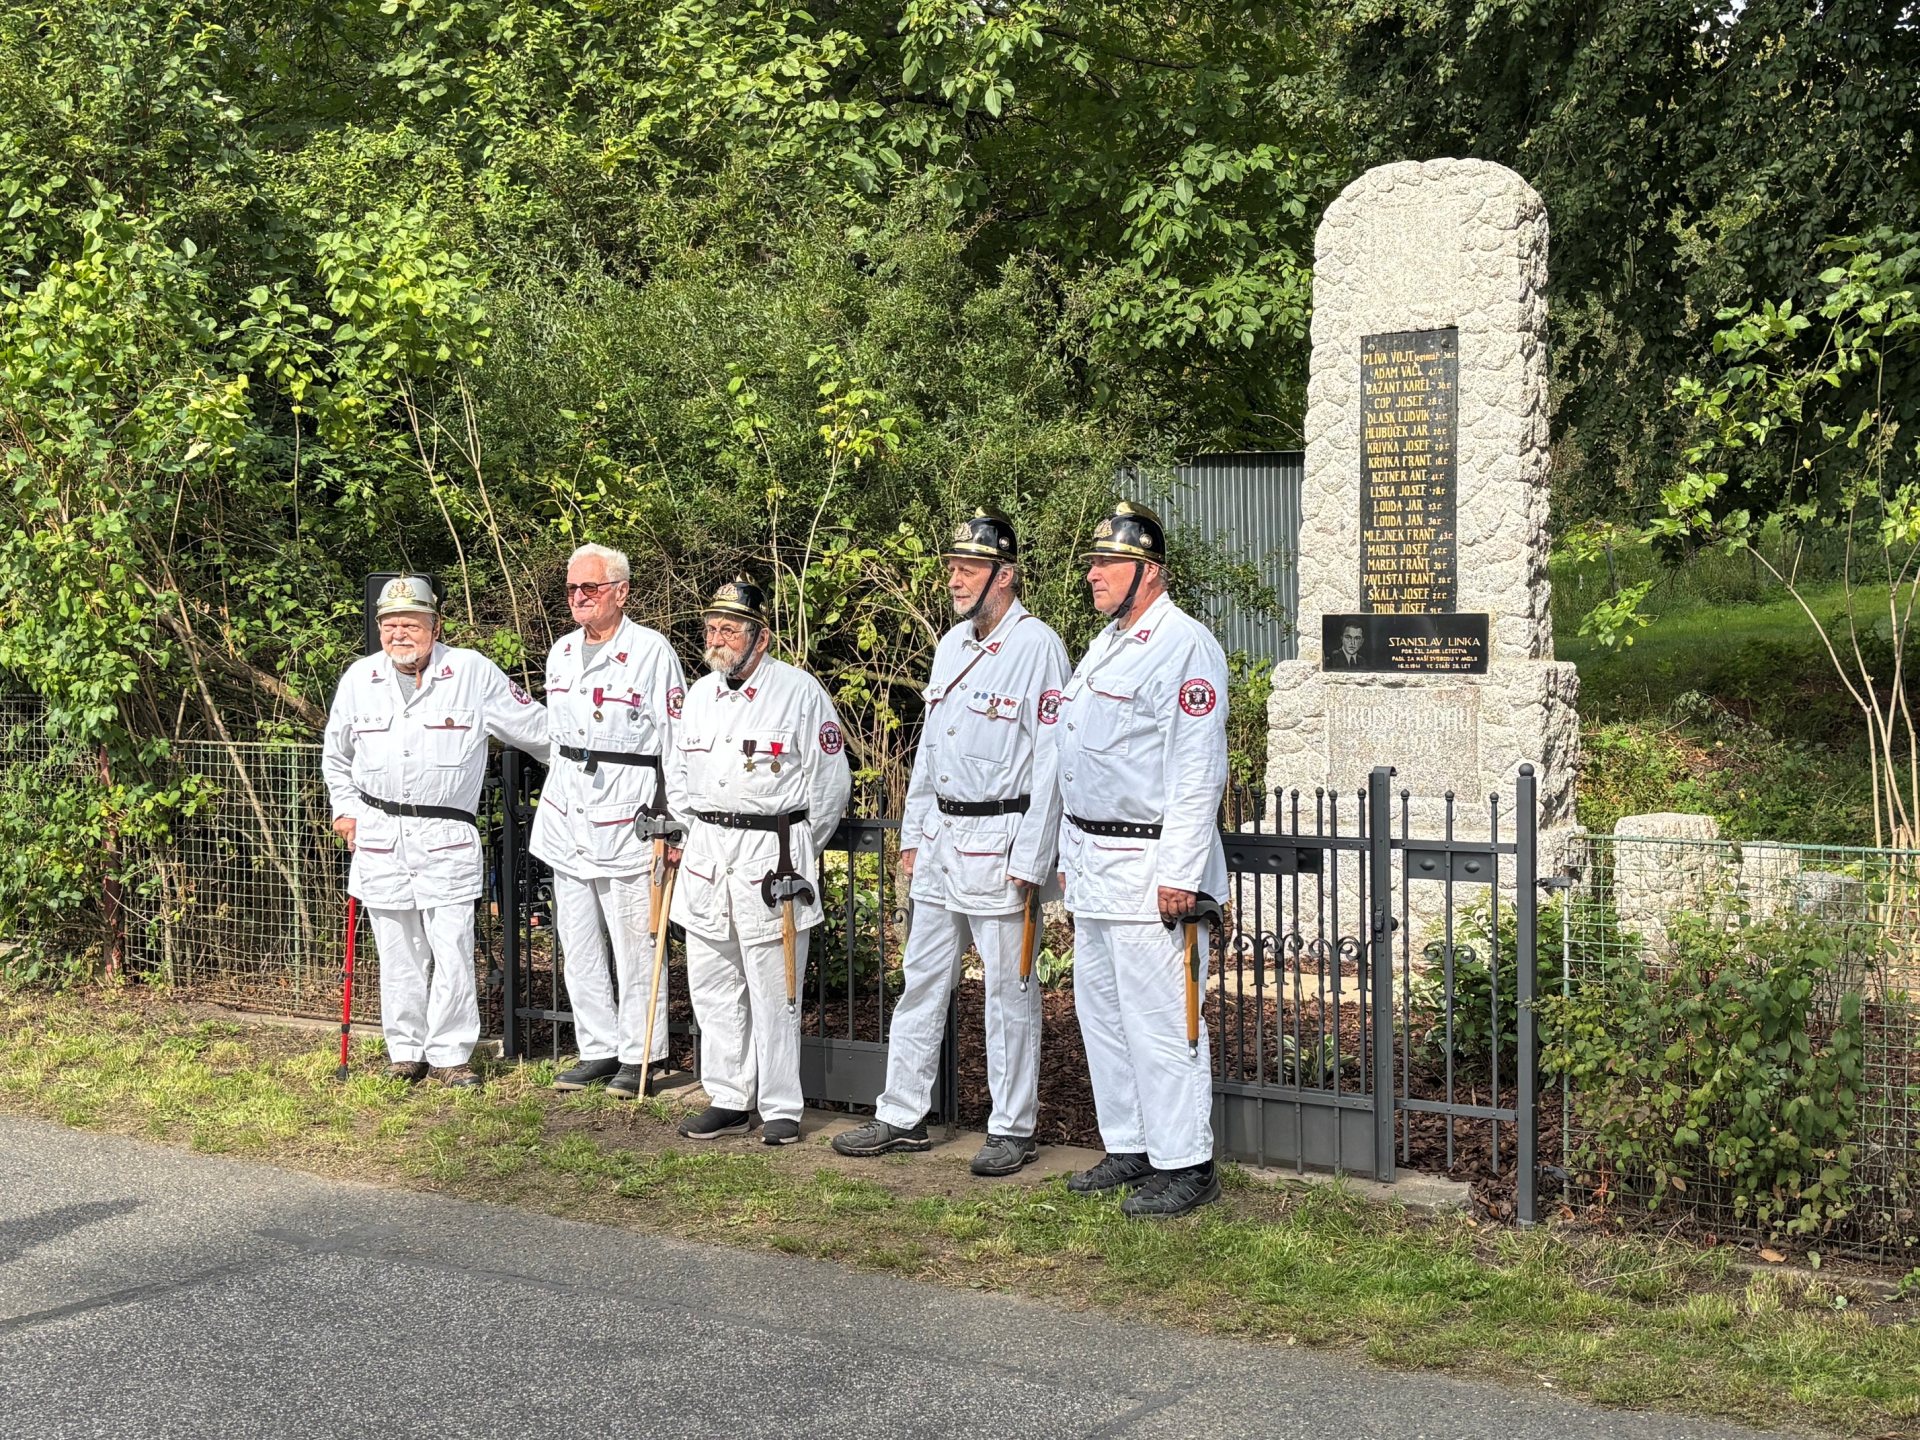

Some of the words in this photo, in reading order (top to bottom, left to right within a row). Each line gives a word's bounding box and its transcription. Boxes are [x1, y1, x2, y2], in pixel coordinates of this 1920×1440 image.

[1363, 351, 1387, 365] PLÍVA
[1374, 367, 1398, 379] ADAM
[1367, 412, 1395, 424] DLASK
[1372, 471, 1407, 483] KETNER
[1373, 500, 1402, 513] LOUDA
[1373, 515, 1402, 527] LOUDA
[1364, 529, 1404, 542] MLEJNEK
[1368, 544, 1397, 556] MAREK
[1368, 559, 1397, 570] MAREK
[1389, 637, 1443, 646] STANISLAV
[1448, 637, 1480, 646] LINKA
